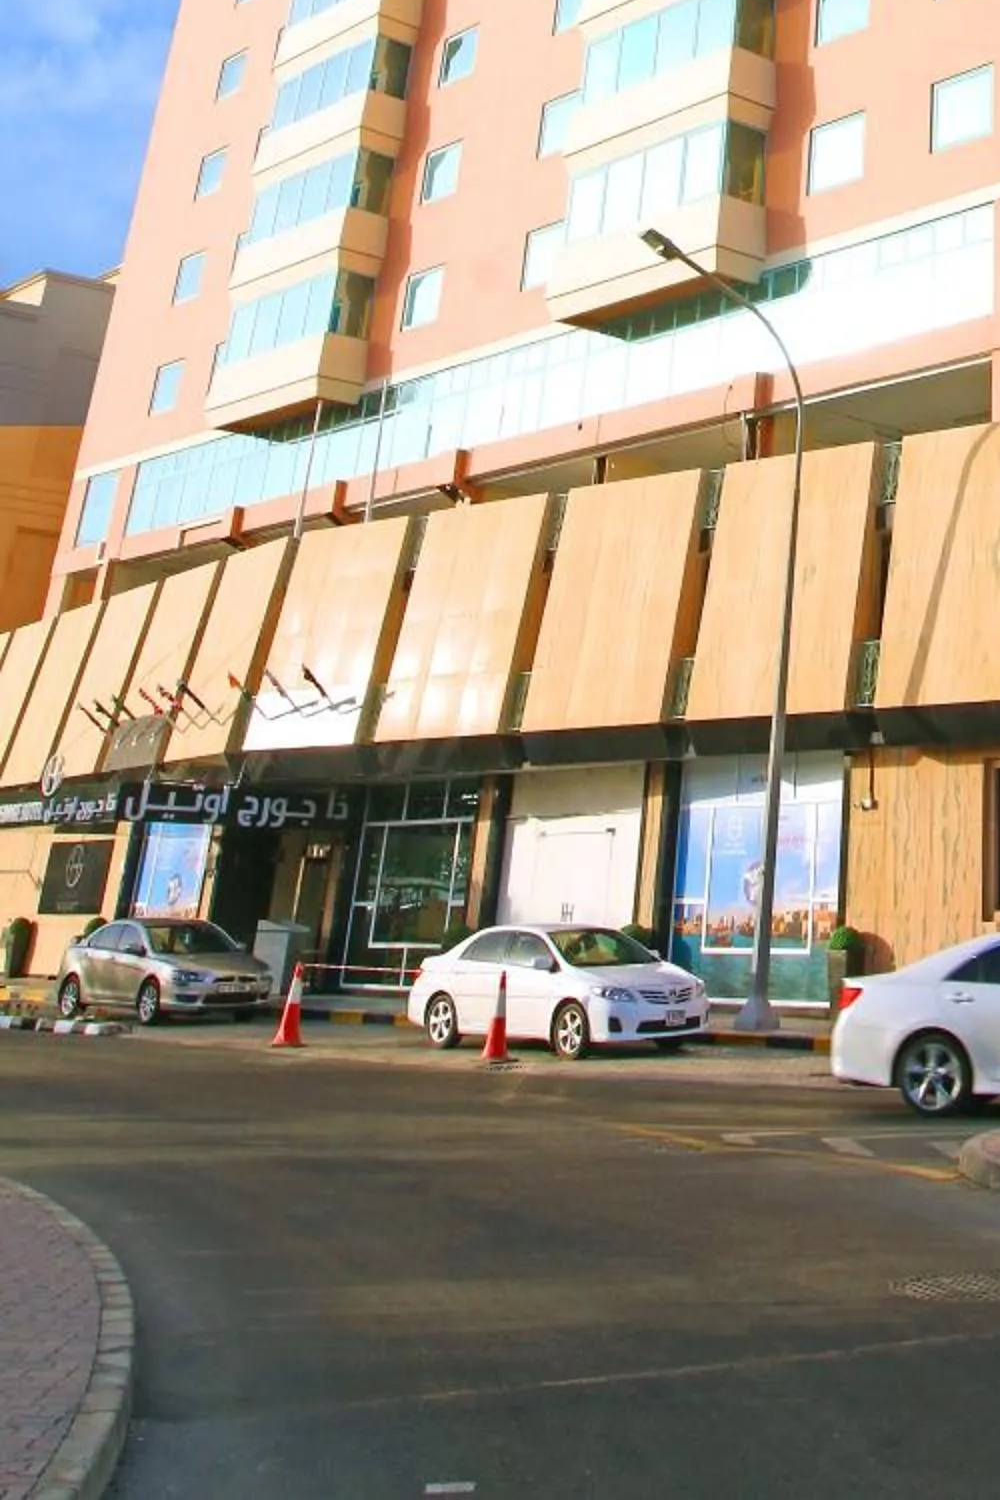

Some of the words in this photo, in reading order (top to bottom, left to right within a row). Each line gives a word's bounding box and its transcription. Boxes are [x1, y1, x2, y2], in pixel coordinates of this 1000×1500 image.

[124, 779, 231, 822] اوتيل
[237, 794, 317, 828] جورج
[325, 786, 348, 820] ذا
